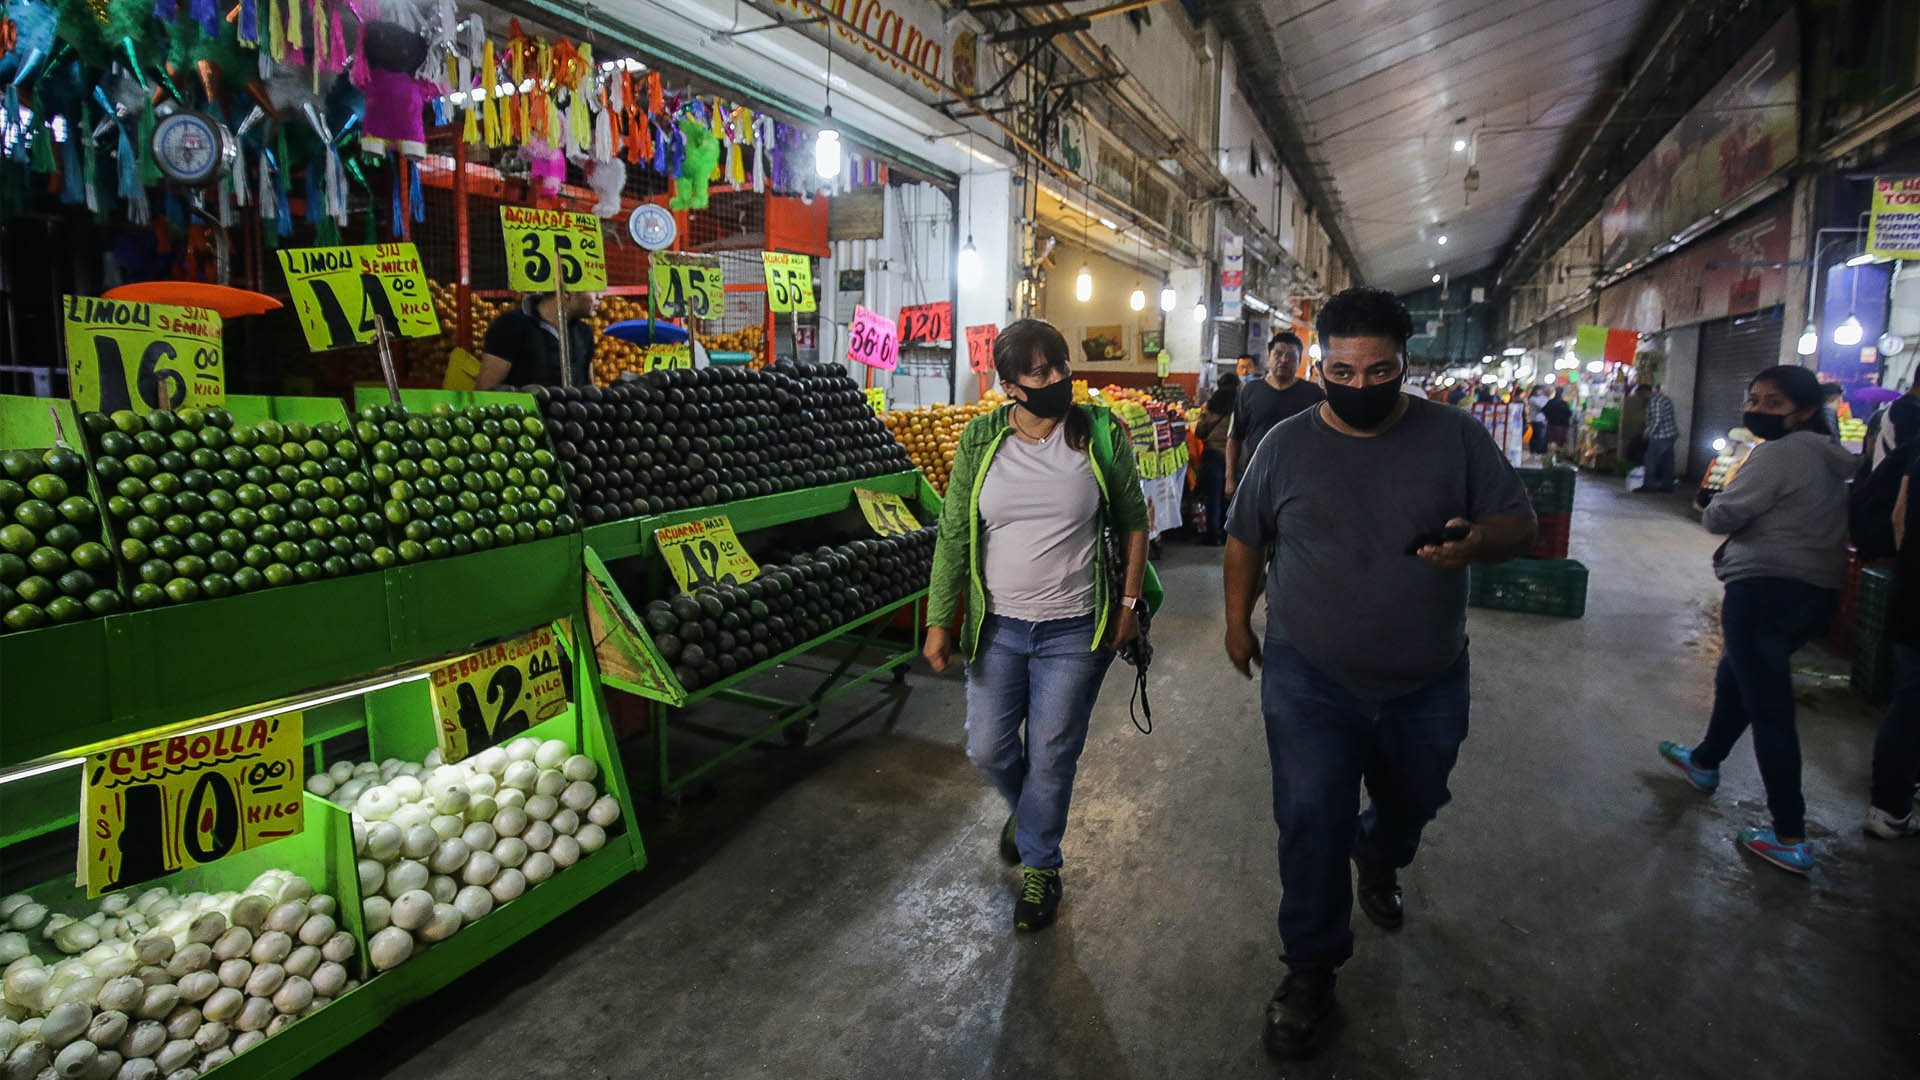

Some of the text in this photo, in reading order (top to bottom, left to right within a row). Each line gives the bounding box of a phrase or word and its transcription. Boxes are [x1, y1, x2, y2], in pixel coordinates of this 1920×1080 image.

[522, 232, 583, 284] 35
[308, 274, 412, 348] 14
[392, 278, 416, 292] 00
[663, 267, 710, 318] 45
[94, 335, 187, 414] 16
[194, 348, 219, 370] 00
[681, 541, 737, 592] 42
[433, 645, 507, 687] CEBOLLA
[533, 678, 560, 697] KILO
[101, 771, 239, 893] 10
[247, 802, 300, 823] KILO
